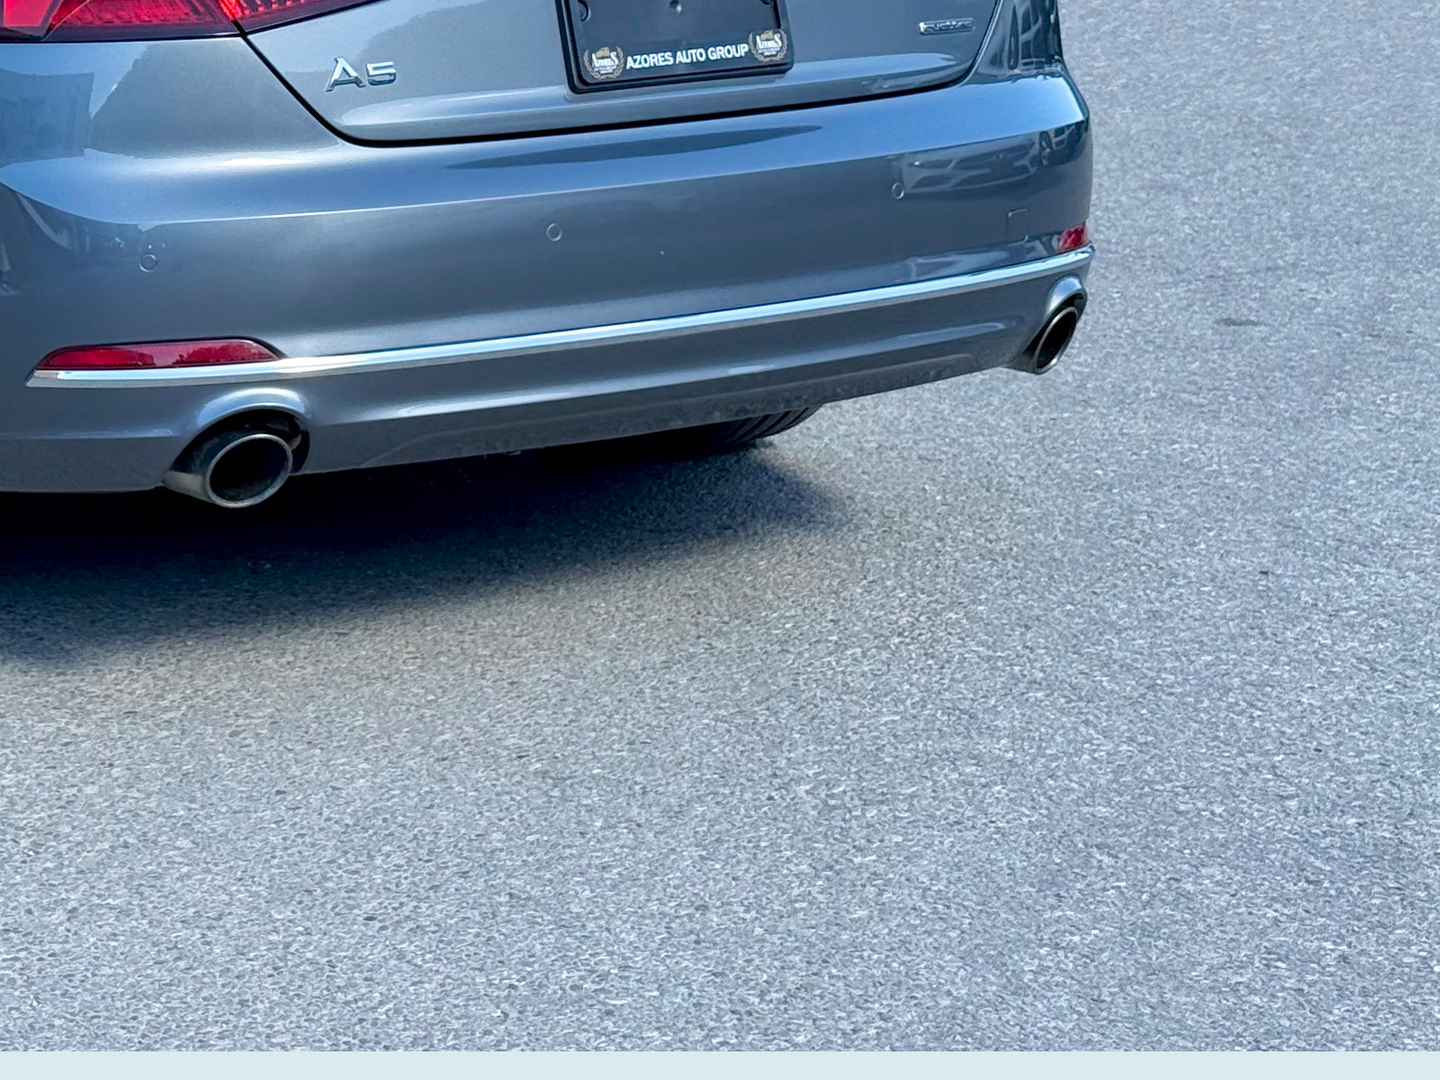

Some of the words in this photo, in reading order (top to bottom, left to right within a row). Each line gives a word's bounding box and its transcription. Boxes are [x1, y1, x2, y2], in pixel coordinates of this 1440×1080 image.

[626, 51, 674, 70] AZORES
[676, 48, 706, 64] AUTO
[707, 43, 749, 60] GROUP
[325, 57, 397, 92] A5
